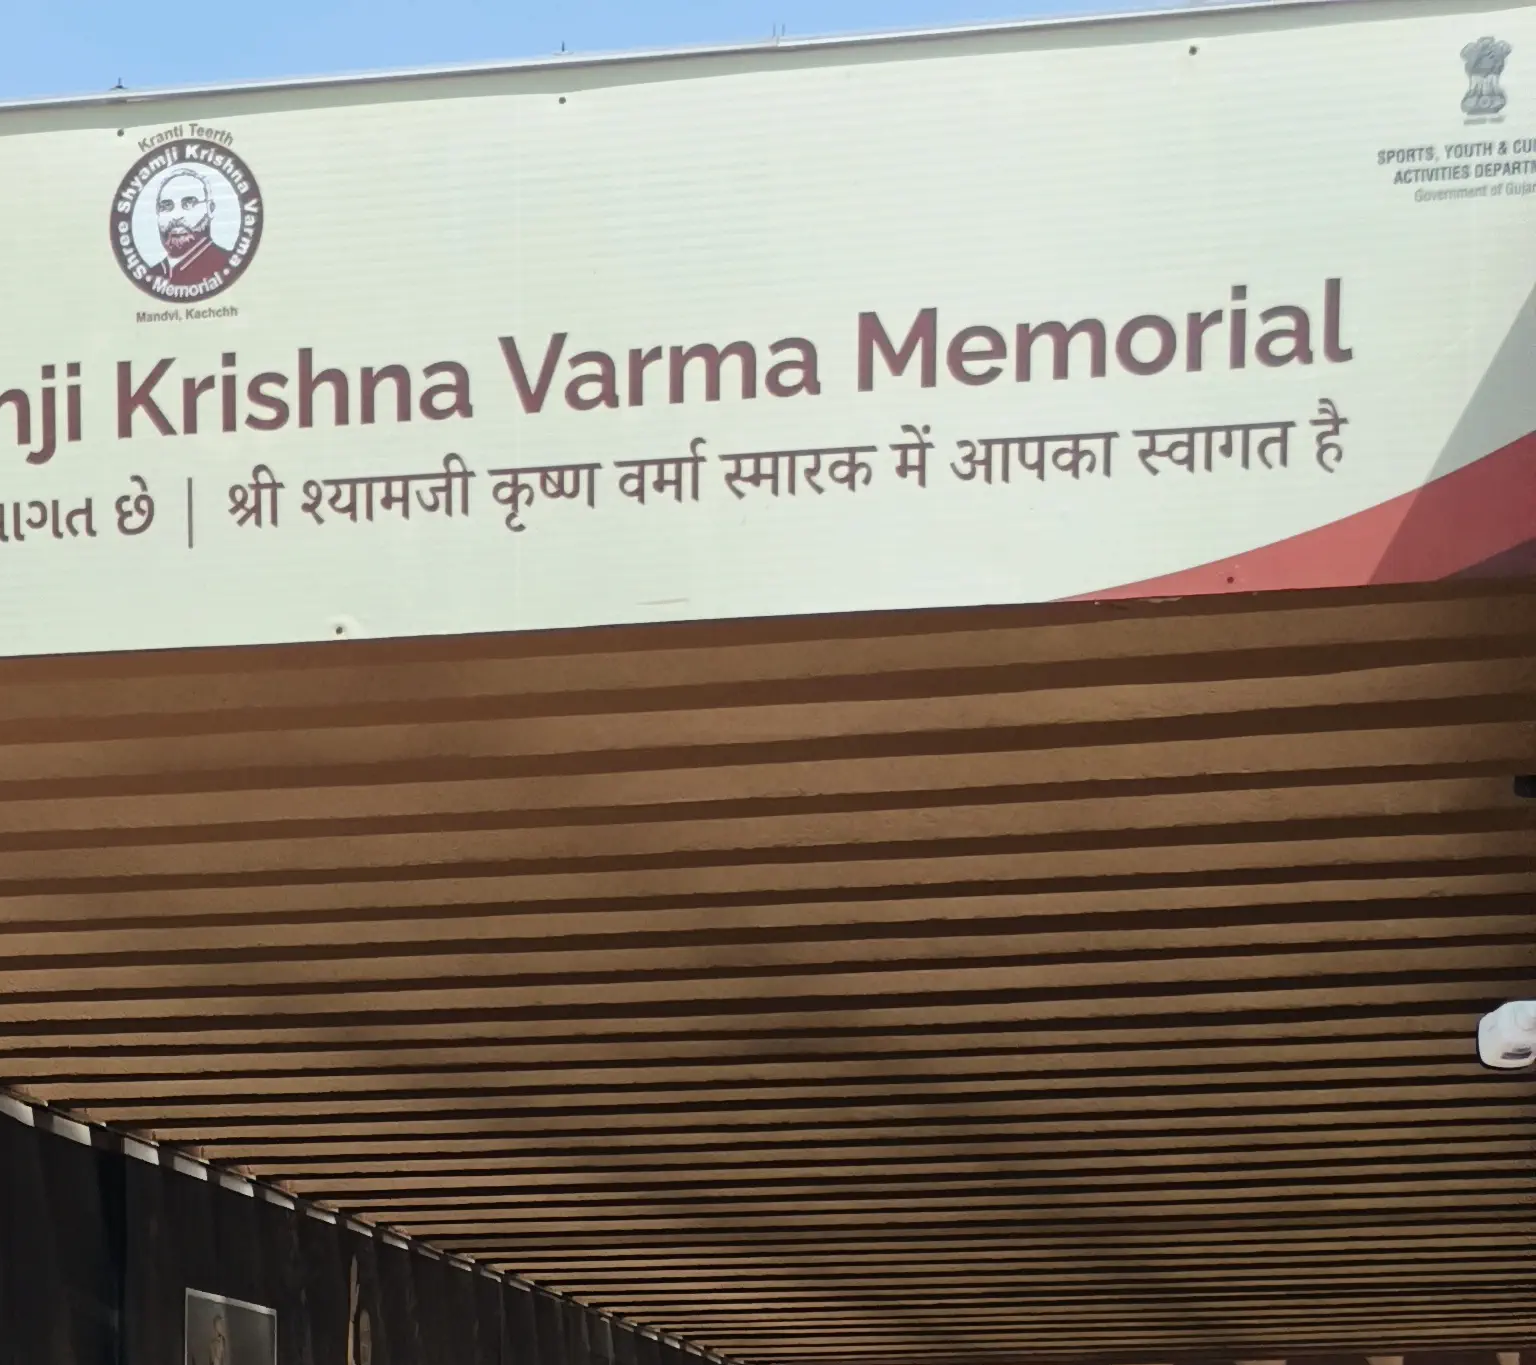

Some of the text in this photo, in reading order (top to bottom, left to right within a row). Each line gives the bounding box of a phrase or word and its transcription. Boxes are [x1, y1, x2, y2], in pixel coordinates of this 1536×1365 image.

[138, 123, 234, 152] Kranti Teerth
[1377, 146, 1440, 165] SPORTS,
[1444, 142, 1492, 159] YOUTH
[1497, 140, 1507, 156] &
[1393, 165, 1470, 184] ACTIVITIES
[1414, 185, 1487, 203] Government
[117, 144, 259, 280] Shree Shyamji Krishna Varma
[152, 271, 224, 298] Memorial
[136, 306, 238, 323] Mandvi, Kachchh
[117, 348, 473, 439] Krishna
[498, 332, 821, 414] Varma
[858, 278, 1353, 391] Memorial
[228, 398, 1349, 532] श्री श्यामजी कृष्ण वर्मा स्मारक में आपका स्वागत है
[115, 475, 154, 535] છે
